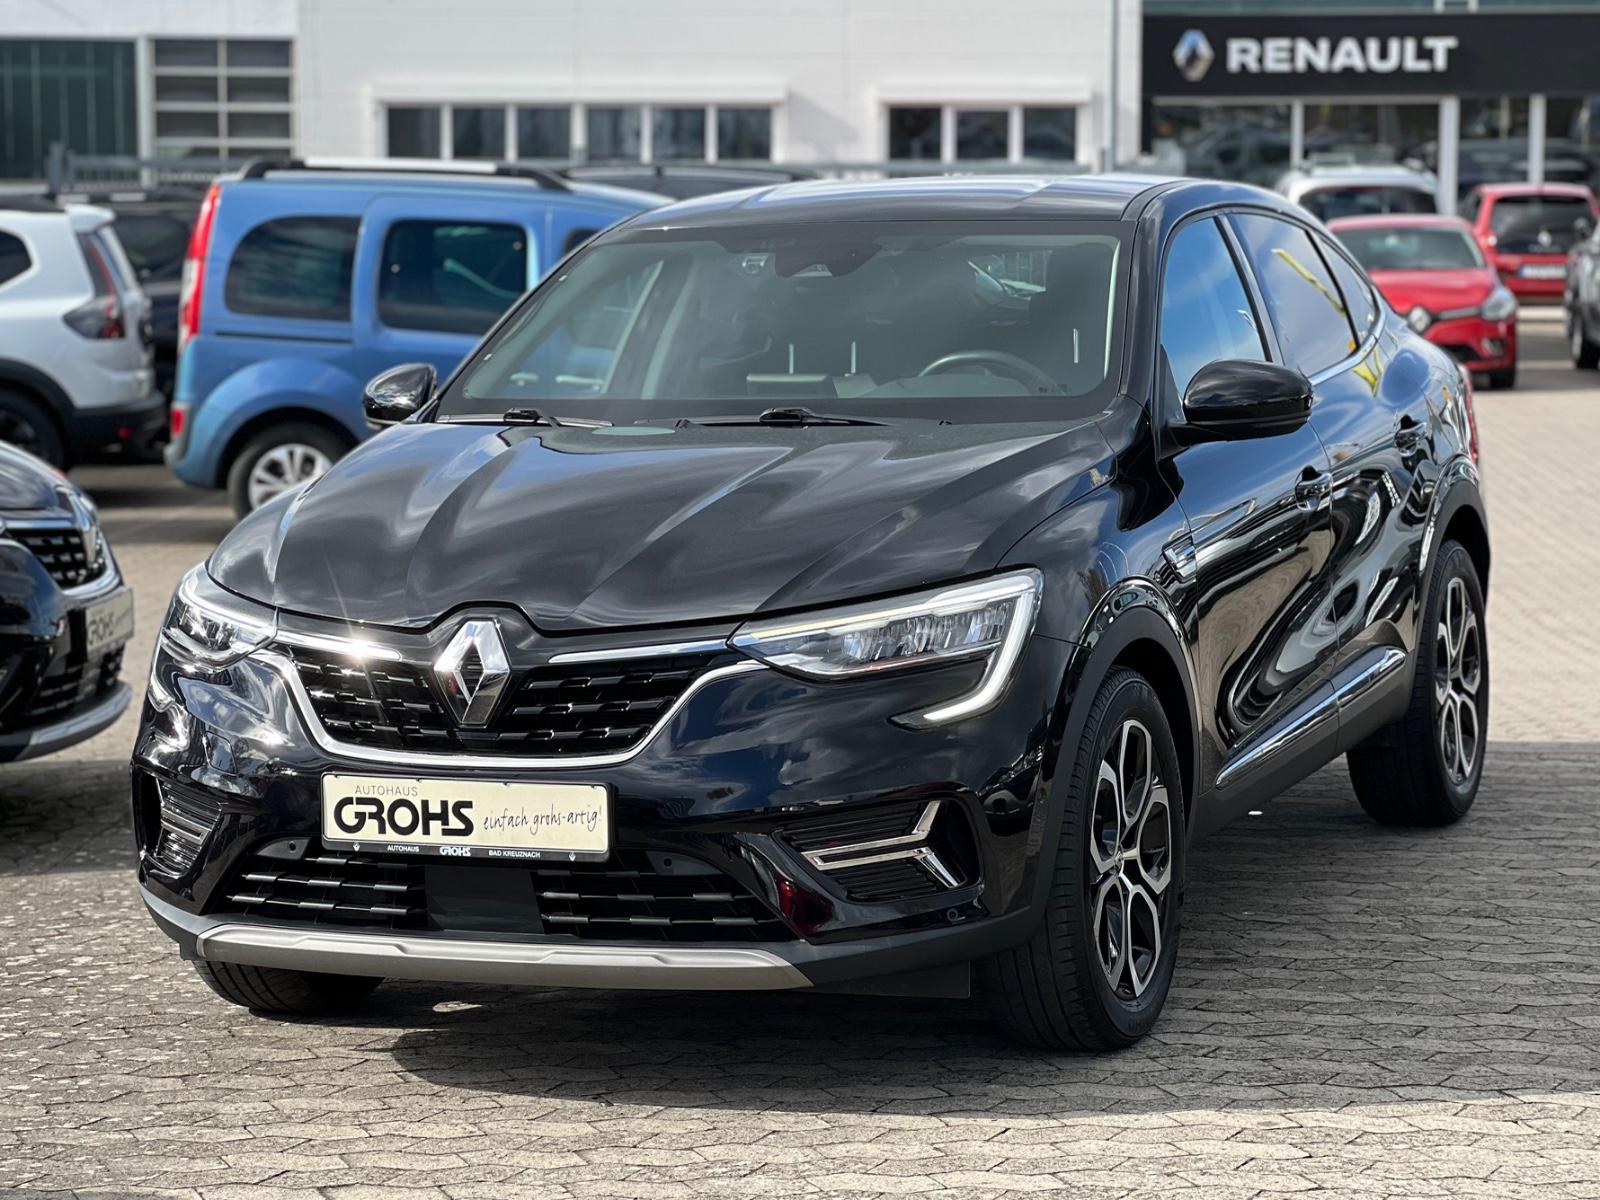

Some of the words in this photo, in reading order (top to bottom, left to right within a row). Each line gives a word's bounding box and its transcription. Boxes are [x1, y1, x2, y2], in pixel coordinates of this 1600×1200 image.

[1226, 36, 1458, 73] RENAULT
[355, 784, 418, 797] AUTOHAUS
[334, 796, 474, 836] GROHS
[483, 806, 529, 832] einfach
[530, 803, 602, 835] grohs-artig!
[387, 844, 420, 853] AUTOHAUS
[440, 846, 471, 857] GROHS
[488, 849, 502, 857] BAD
[502, 850, 541, 859] KREUZNACH
